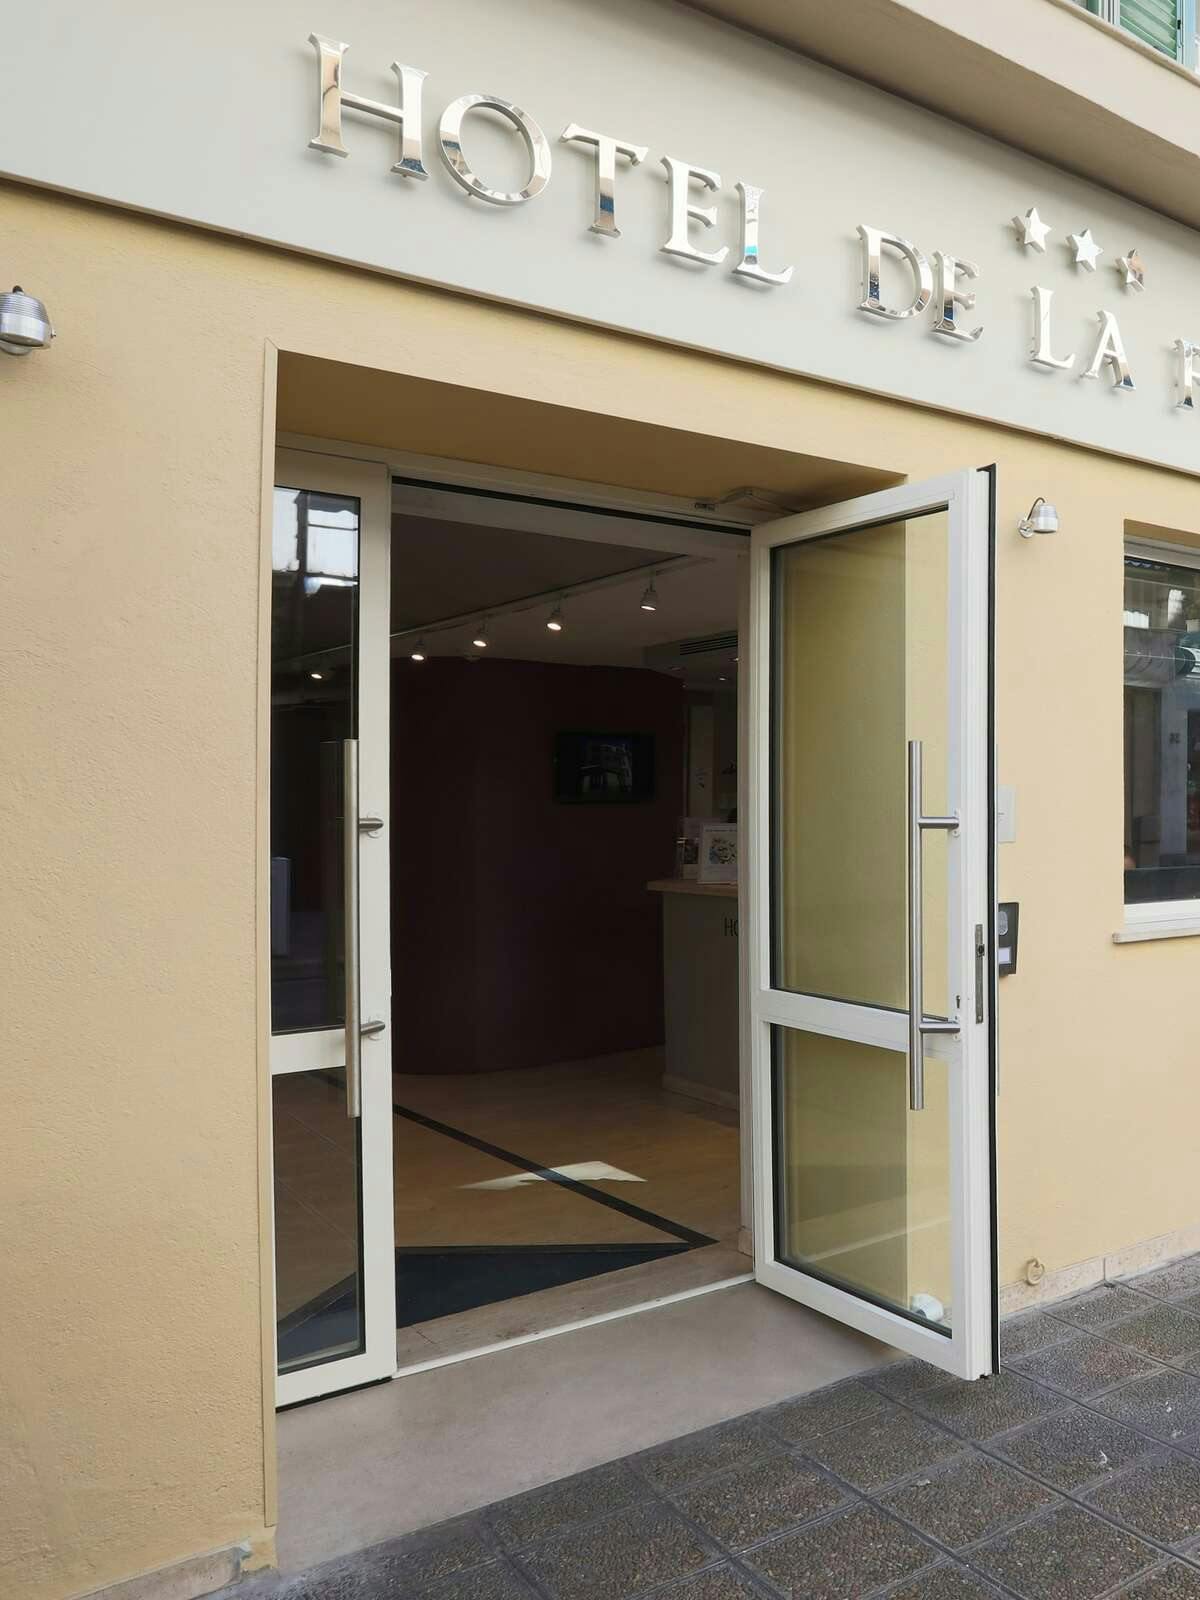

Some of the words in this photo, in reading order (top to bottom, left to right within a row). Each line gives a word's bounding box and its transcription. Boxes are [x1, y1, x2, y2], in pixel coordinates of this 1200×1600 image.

[308, 33, 796, 285] HOTEL
[856, 224, 985, 343] DE
[1029, 286, 1137, 392] LA
